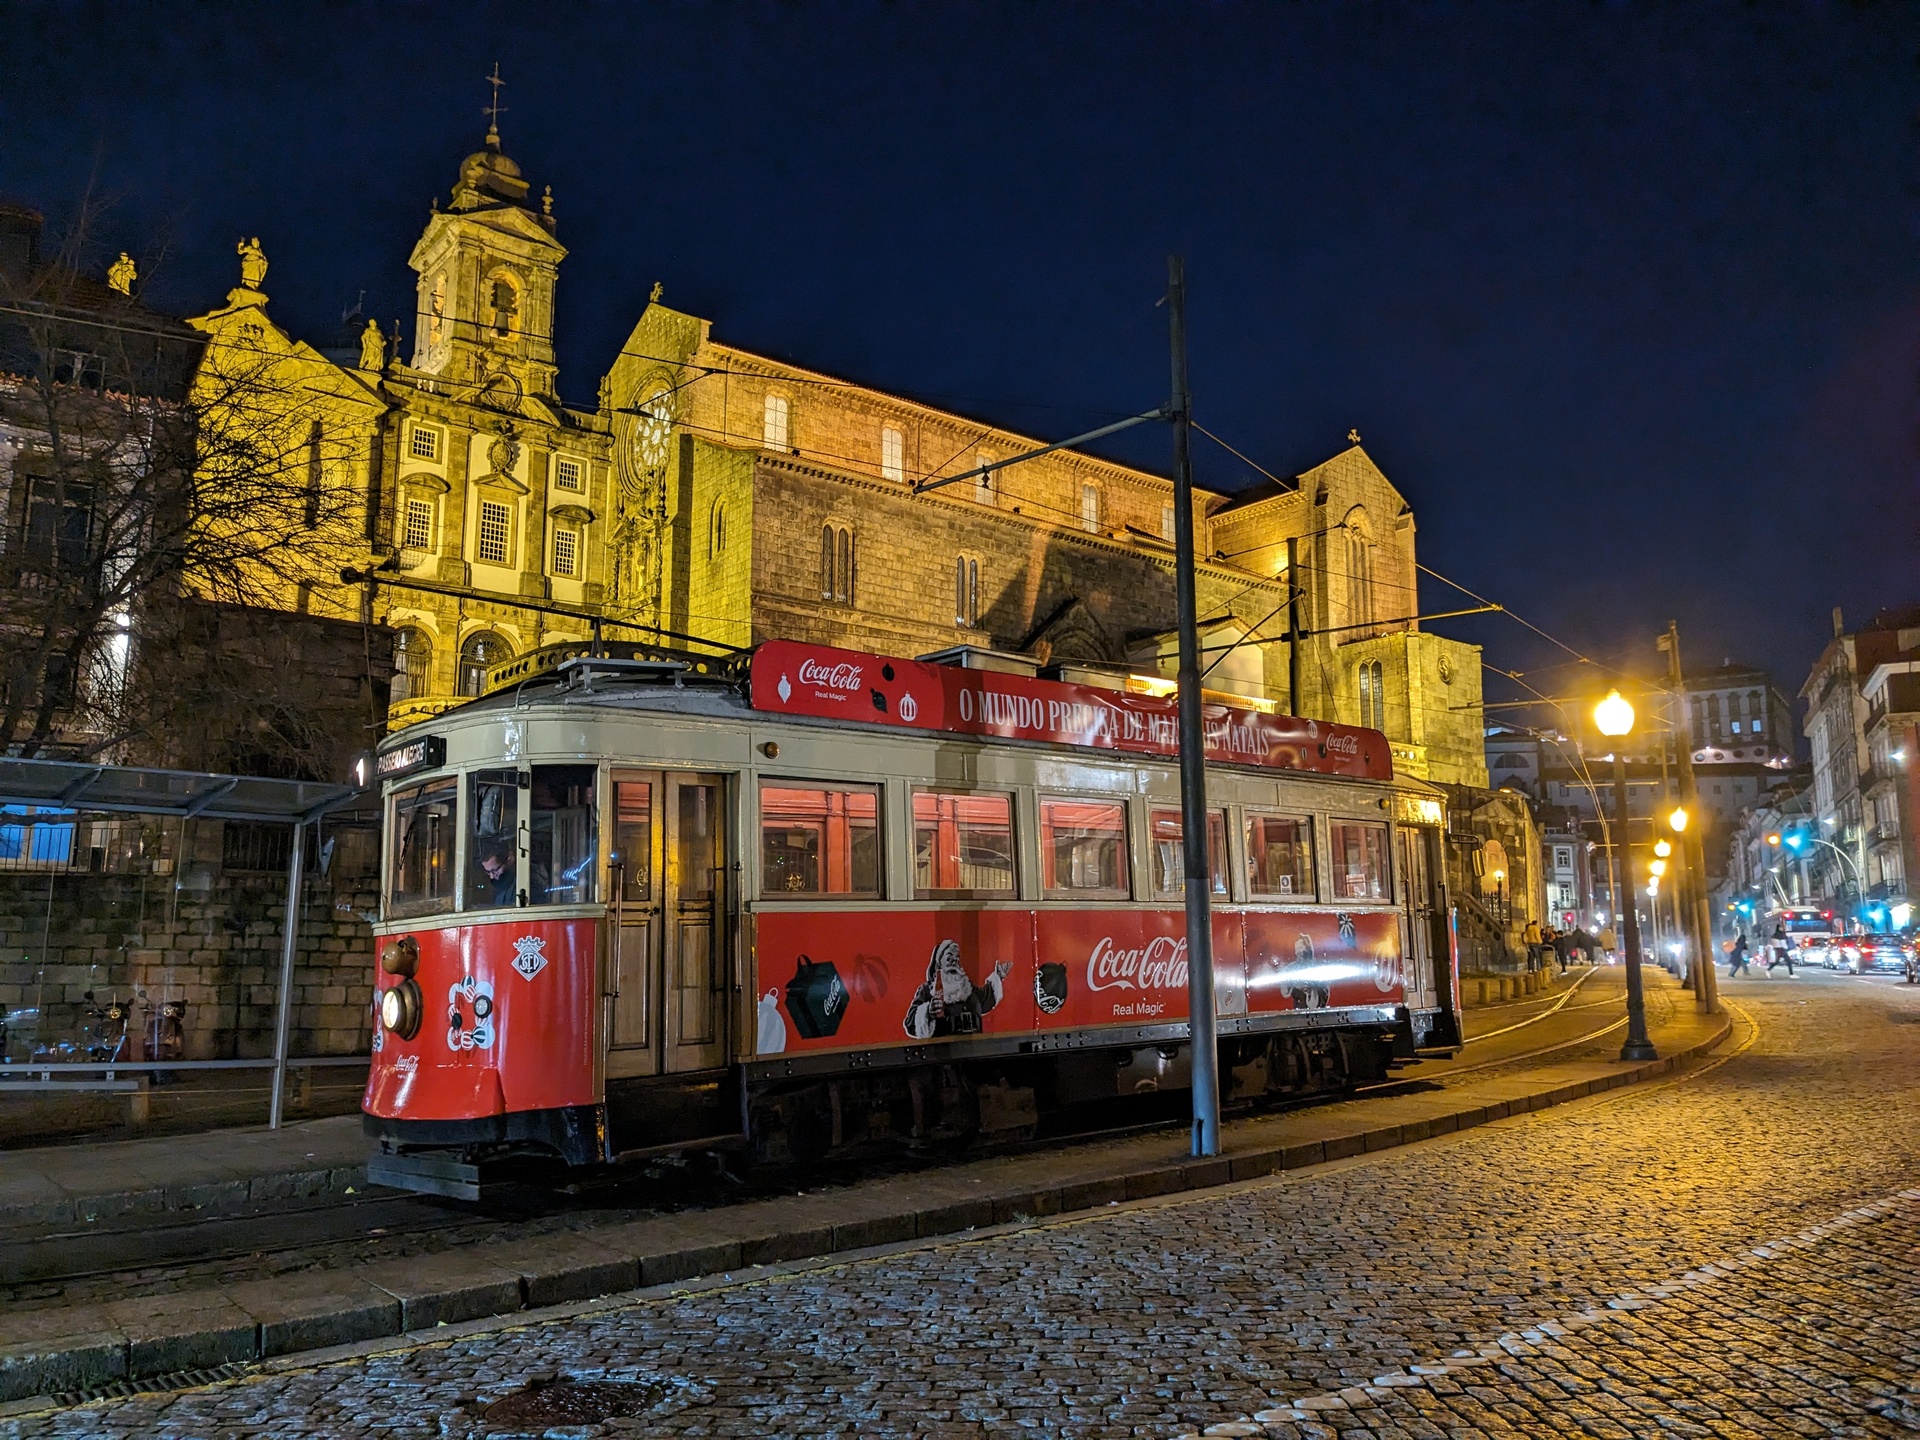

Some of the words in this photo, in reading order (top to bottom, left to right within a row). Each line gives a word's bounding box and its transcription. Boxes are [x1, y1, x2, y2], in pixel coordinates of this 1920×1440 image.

[799, 658, 864, 691] Coca-Cola
[815, 690, 828, 699] Real
[829, 692, 847, 701] Magic
[959, 688, 973, 722] O
[977, 690, 1044, 730] MUNDO
[1048, 700, 1119, 738] PRECISA
[1123, 709, 1145, 741] DE
[1222, 722, 1270, 756] NATAIS
[355, 758, 365, 787] 1
[377, 749, 402, 774] PASSEIO
[401, 741, 425, 767] ALEGRE
[1087, 936, 1191, 992] Coca-Cola
[1112, 1003, 1135, 1016] Real
[1136, 1002, 1164, 1016] Magic
